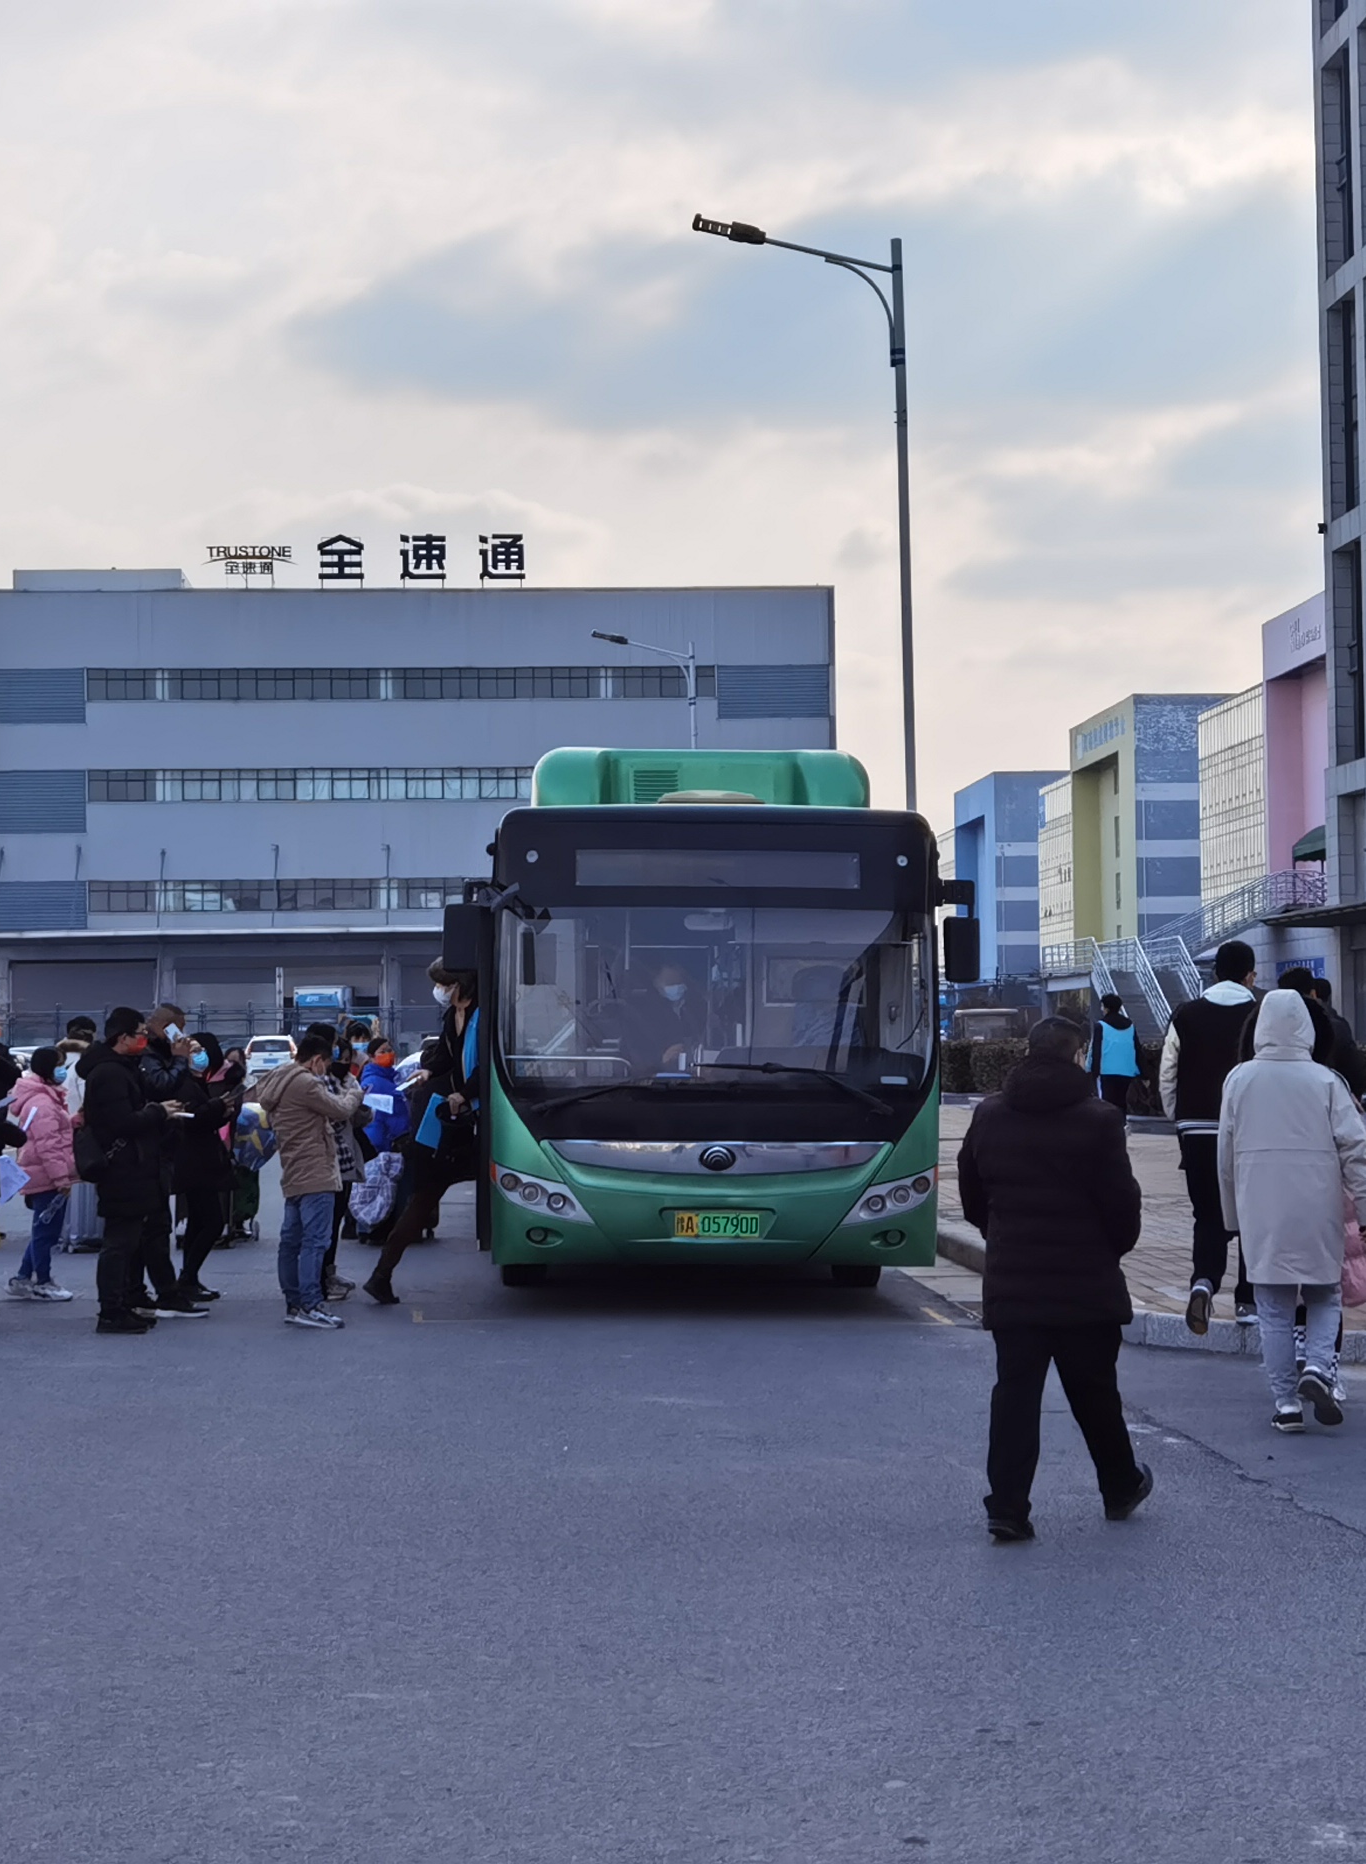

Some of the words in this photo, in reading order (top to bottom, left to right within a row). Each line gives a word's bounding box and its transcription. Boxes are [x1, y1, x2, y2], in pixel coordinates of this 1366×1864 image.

[206, 546, 291, 557] TRUSTONE
[317, 534, 525, 579] 全速通
[225, 561, 273, 574] 全速通
